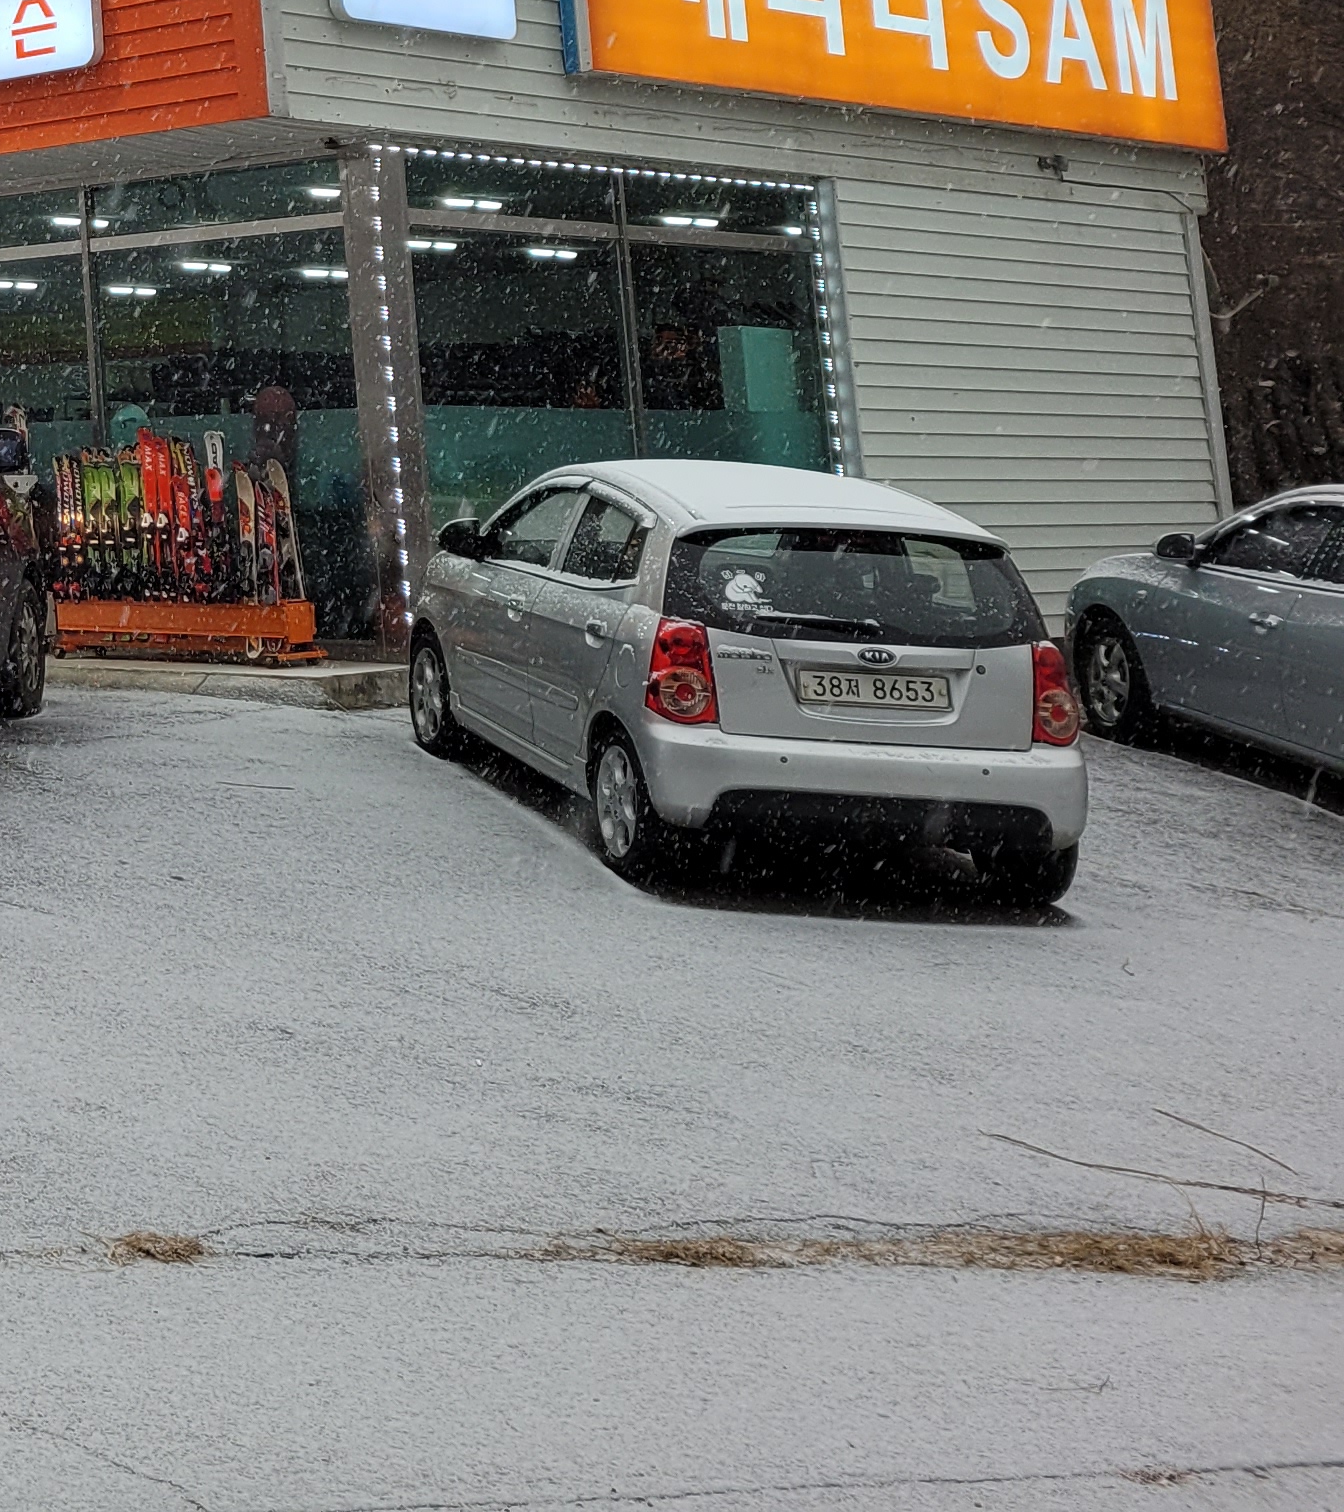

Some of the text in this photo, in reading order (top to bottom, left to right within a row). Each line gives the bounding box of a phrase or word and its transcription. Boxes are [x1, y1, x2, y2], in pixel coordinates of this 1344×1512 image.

[864, 651, 889, 661] KIA
[812, 674, 935, 703] 38저 8653
